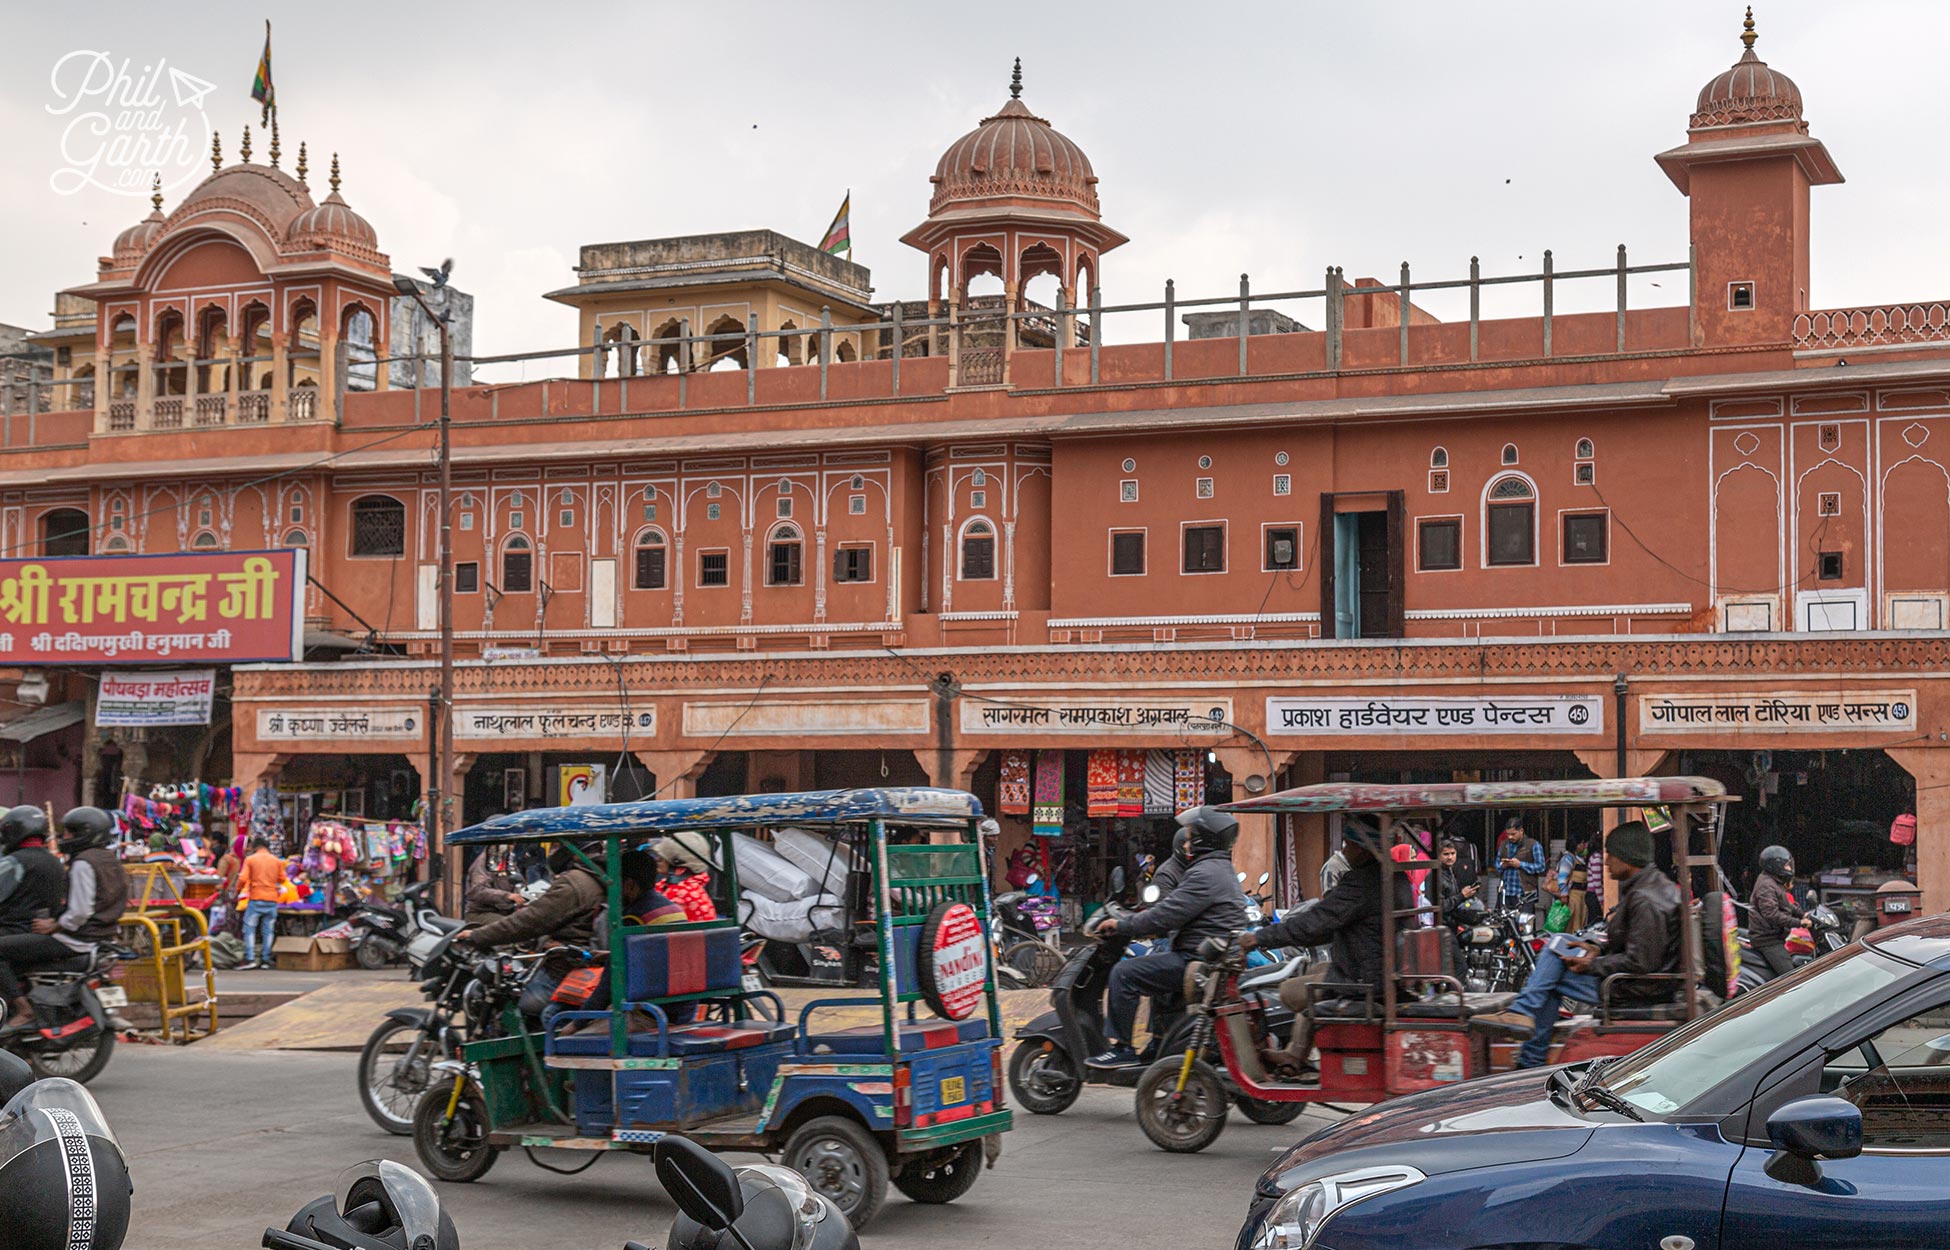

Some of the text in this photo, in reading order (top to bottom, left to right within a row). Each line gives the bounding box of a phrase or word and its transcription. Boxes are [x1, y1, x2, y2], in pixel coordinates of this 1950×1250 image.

[0, 556, 279, 625] श्री रामचन्द्र जी
[30, 632, 52, 652] श्री
[54, 631, 143, 656] दक्षिणमुखी
[146, 632, 204, 656] हनुमान
[207, 628, 232, 649] जी
[153, 676, 211, 698] महोत्सव
[473, 714, 535, 734] नाथूलाल
[982, 707, 1050, 728] सागरमल
[1136, 707, 1191, 728] अग्रवाल
[1281, 707, 1332, 728] प्रकाश
[1339, 702, 1430, 729] हार्डवेयर
[1436, 706, 1476, 726] एण्ड
[1569, 707, 1588, 721] 450
[1651, 699, 1909, 725] गोपाल लाल टोरिया एण्ड सन्स 451
[268, 714, 284, 732] श्री
[287, 717, 325, 737] कृष्णा
